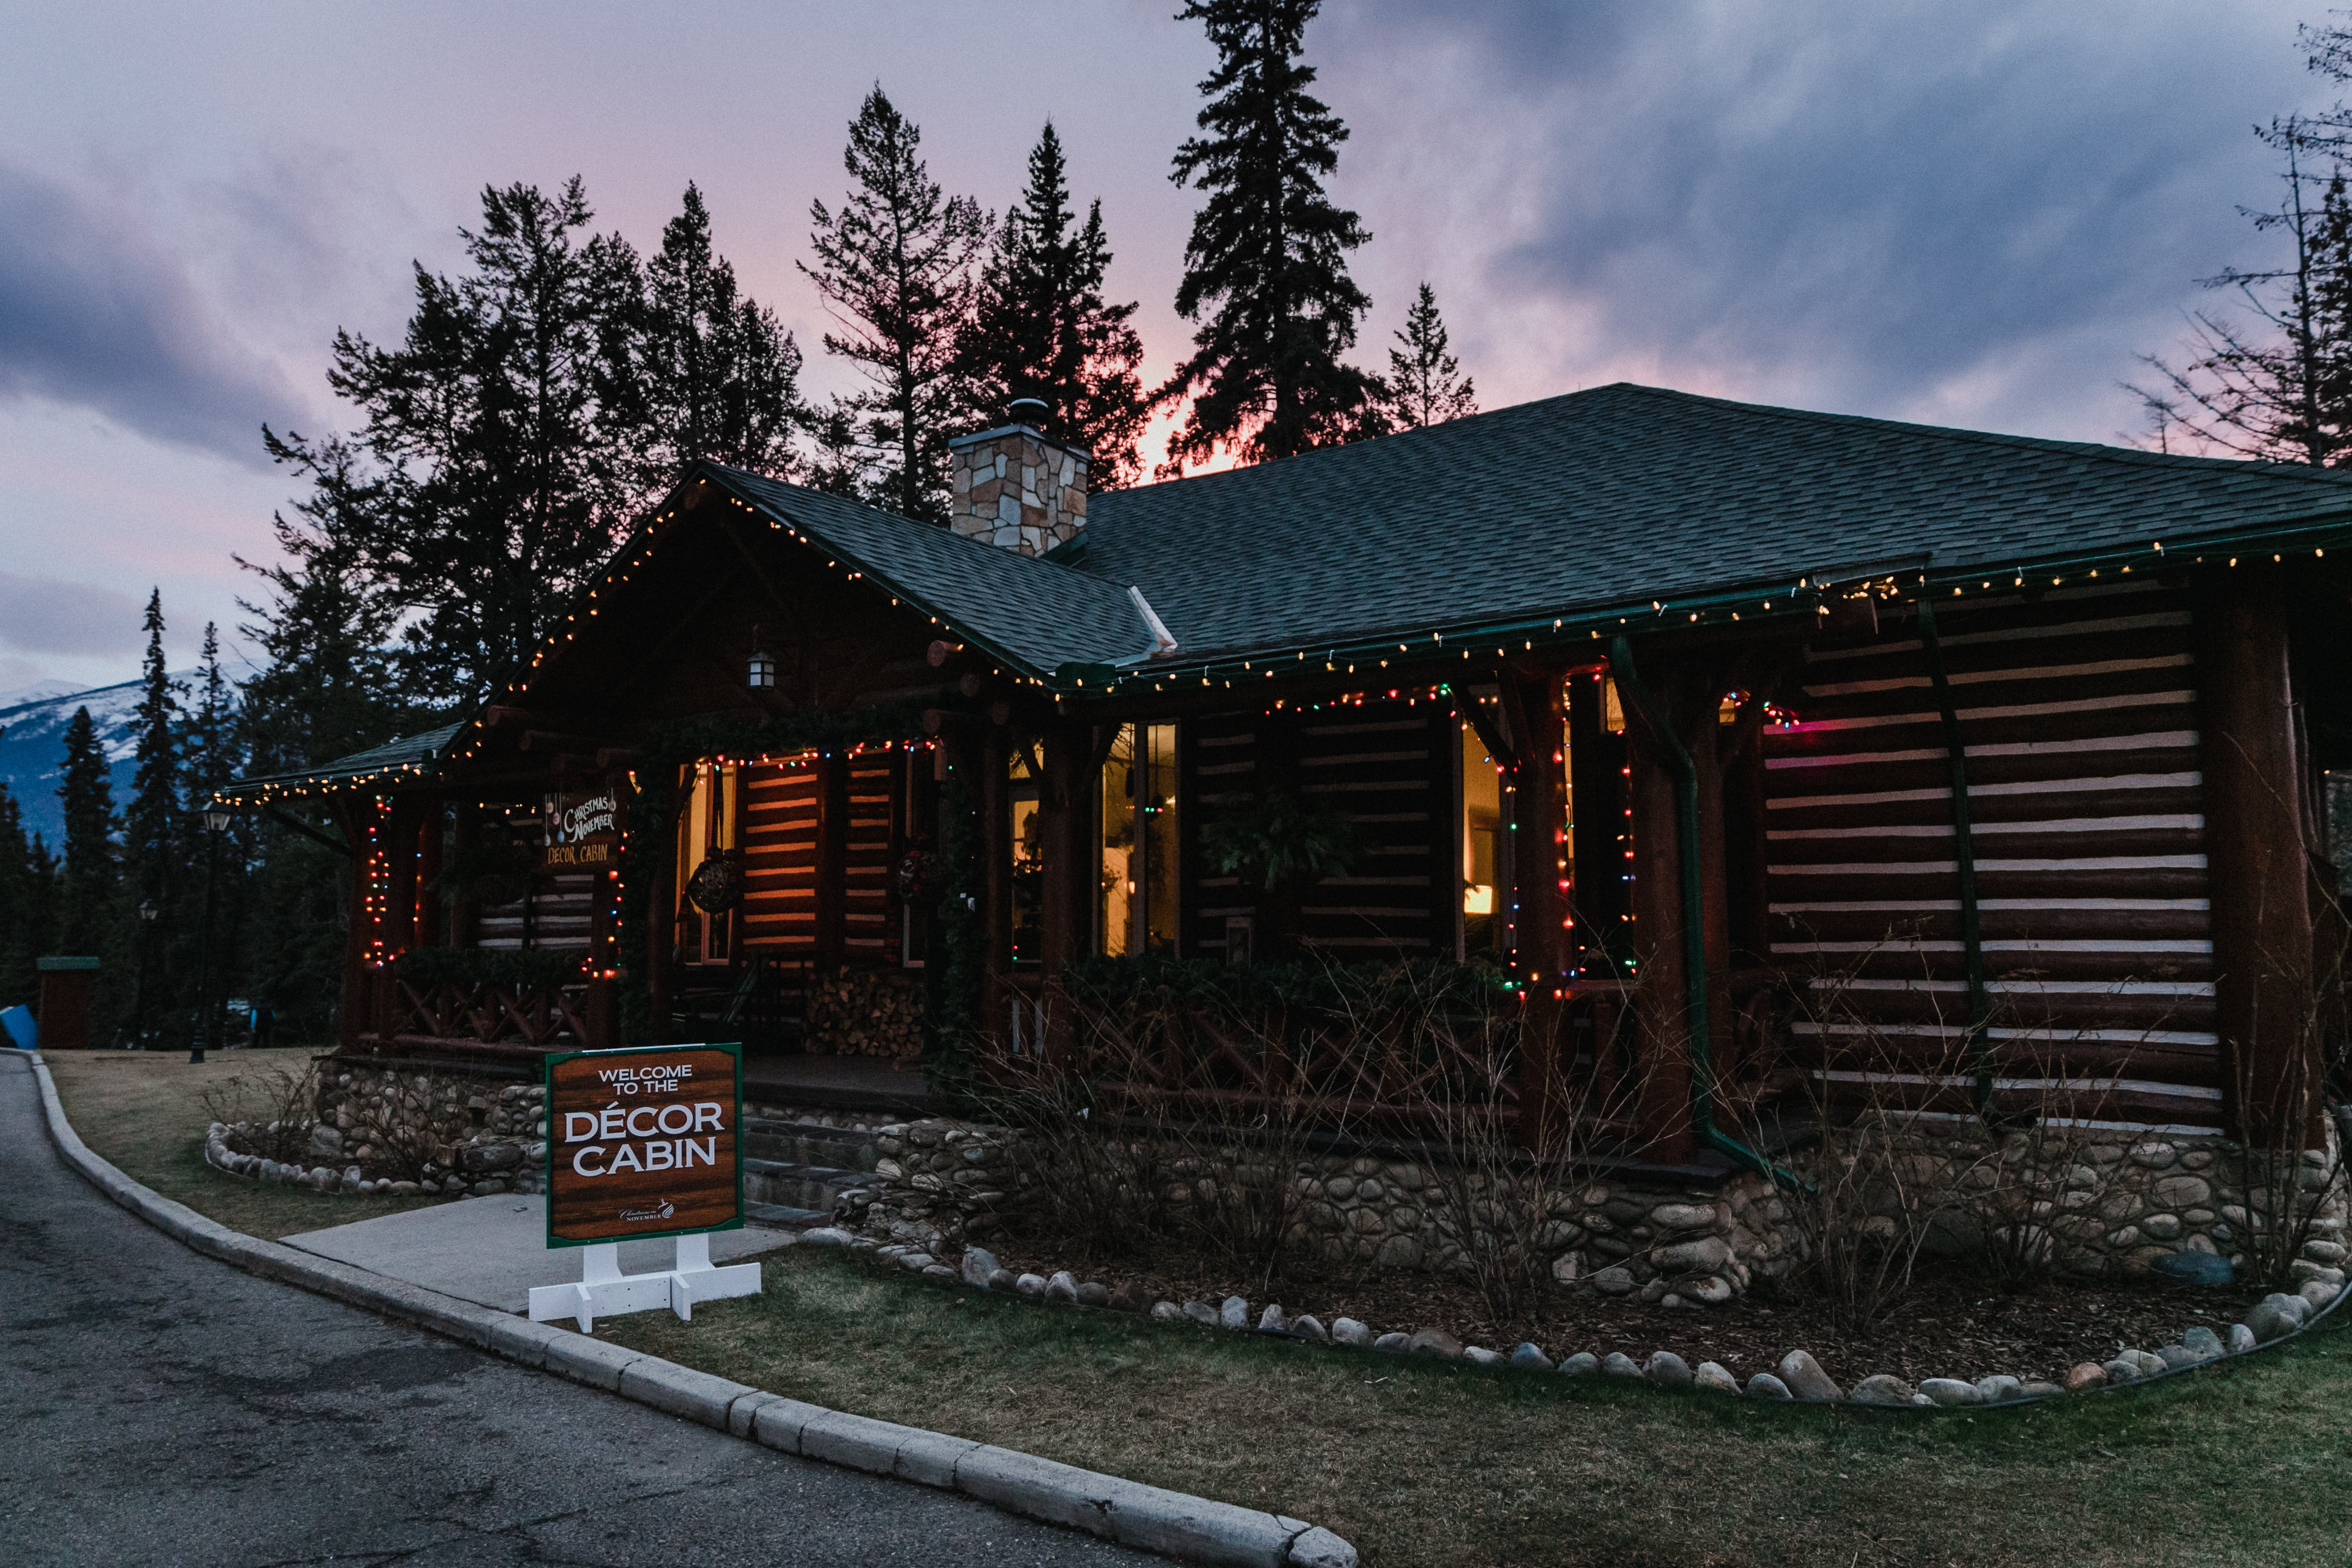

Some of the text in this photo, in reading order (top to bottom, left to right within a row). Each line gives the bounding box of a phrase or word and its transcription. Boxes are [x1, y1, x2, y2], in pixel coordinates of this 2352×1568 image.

[568, 814, 615, 843] NOVEMBER
[548, 844, 608, 865] DECOR CABIN
[598, 1065, 692, 1082] WELCOME
[613, 1079, 678, 1095] TO THE
[564, 1101, 724, 1143] DÉCOR
[573, 1137, 716, 1177] CABIN
